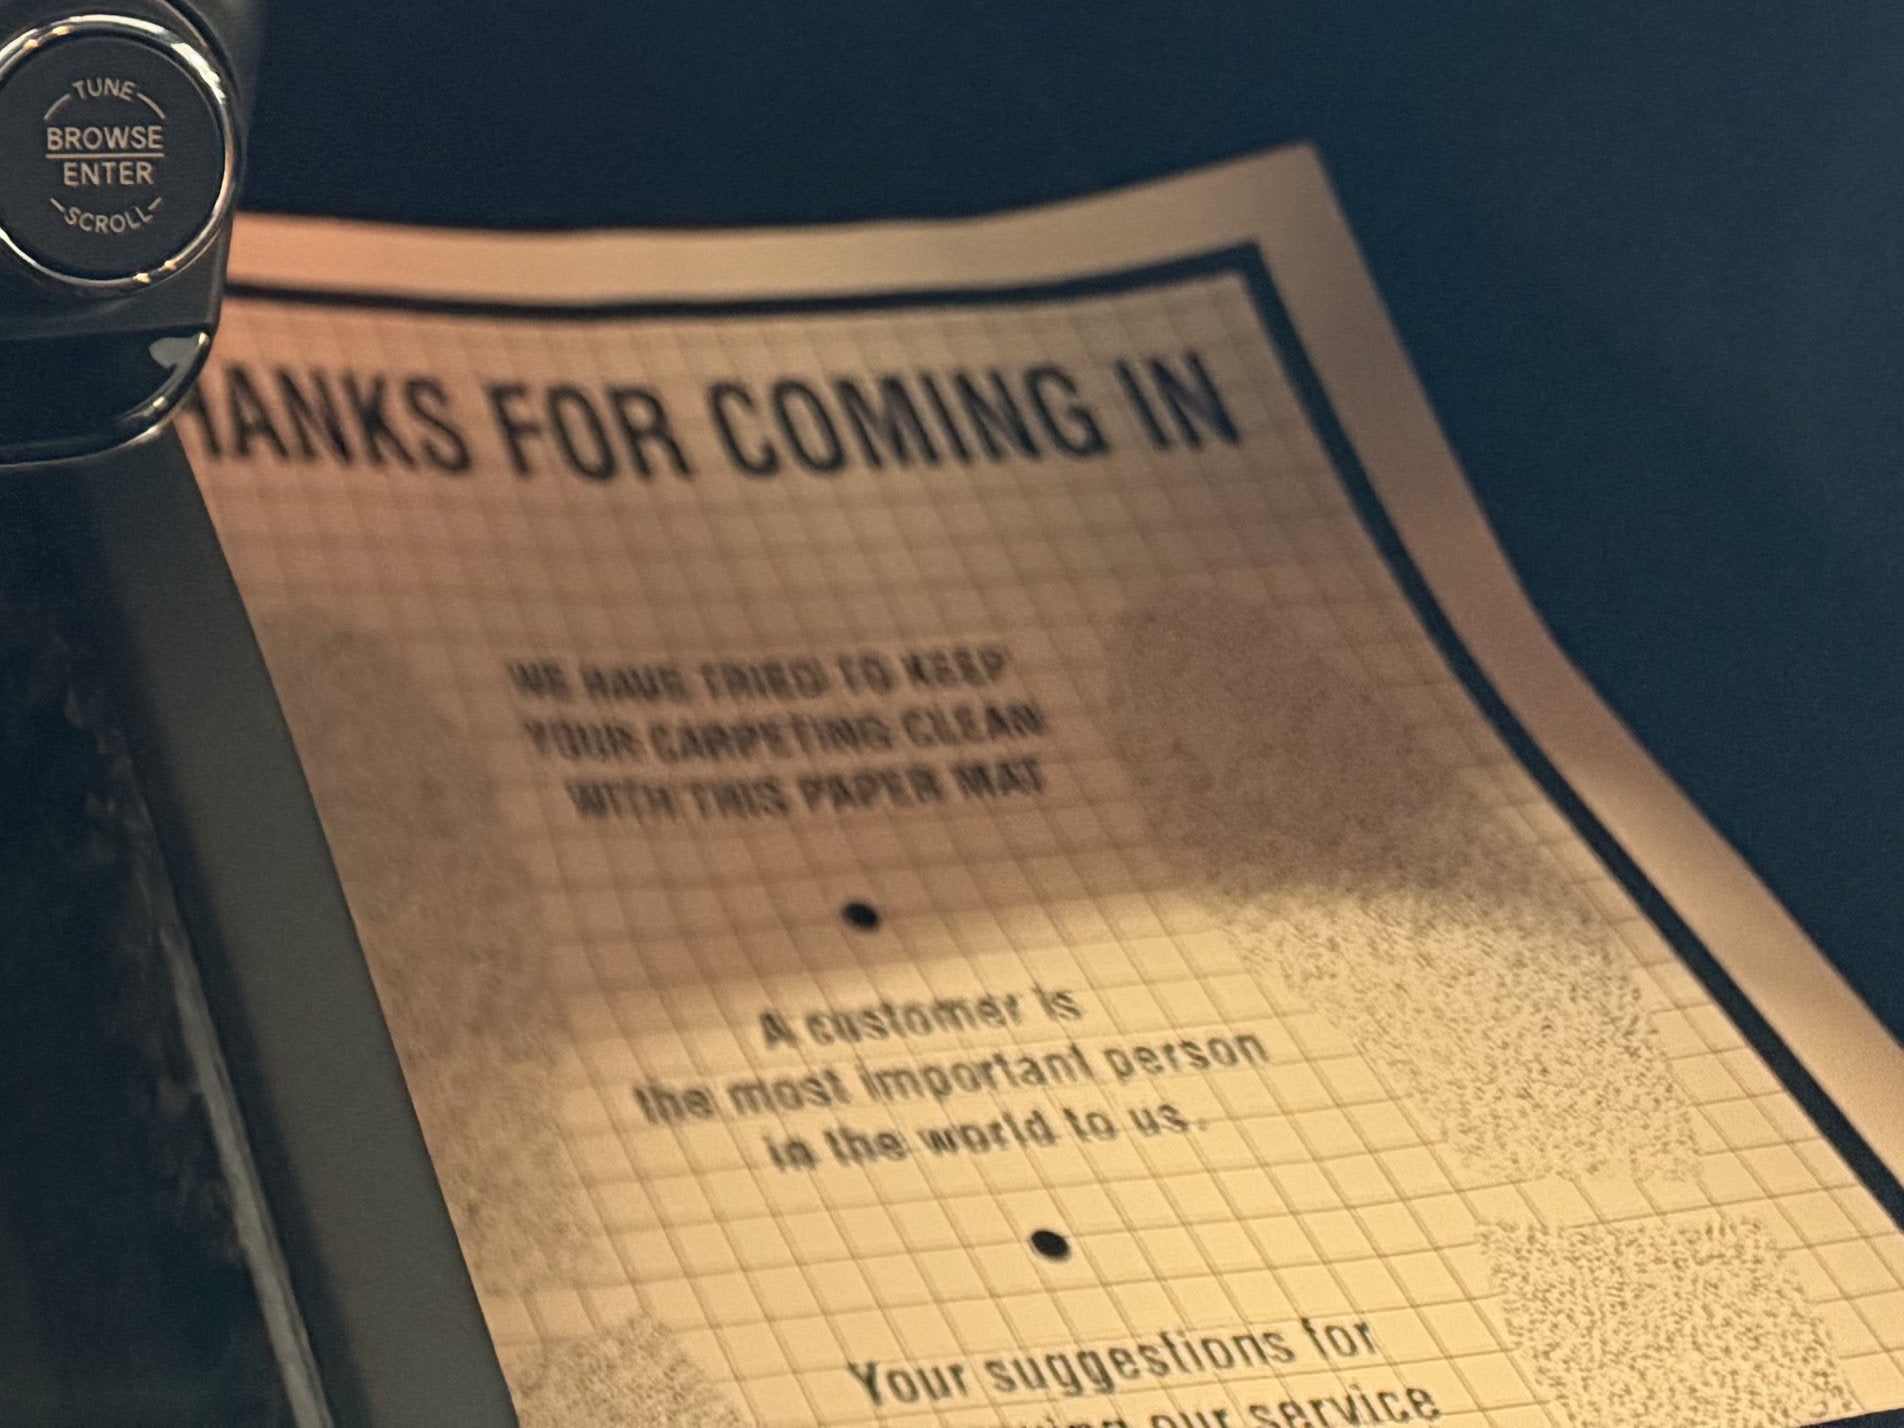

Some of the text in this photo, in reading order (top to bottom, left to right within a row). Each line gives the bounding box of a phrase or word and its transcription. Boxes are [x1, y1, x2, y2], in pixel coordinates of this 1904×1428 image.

[72, 78, 136, 102] TUNE
[47, 126, 163, 151] BROWSE
[63, 161, 153, 186] ENTER
[63, 205, 153, 234] SCROLL
[182, 349, 1245, 484] ANKS FOR COMING IN
[507, 658, 570, 700] WE
[838, 650, 896, 695] TO
[903, 641, 1009, 687] KEEP
[901, 697, 1049, 745] CLEAN
[566, 755, 1046, 821] WITH THIS PAPER MAT
[758, 985, 1084, 1050] A customer is
[633, 1028, 1271, 1127] the most important person
[762, 1095, 1208, 1172] in the world to us.
[848, 1316, 1379, 1409] Your suggestions for
[1248, 1381, 1442, 1428] service
